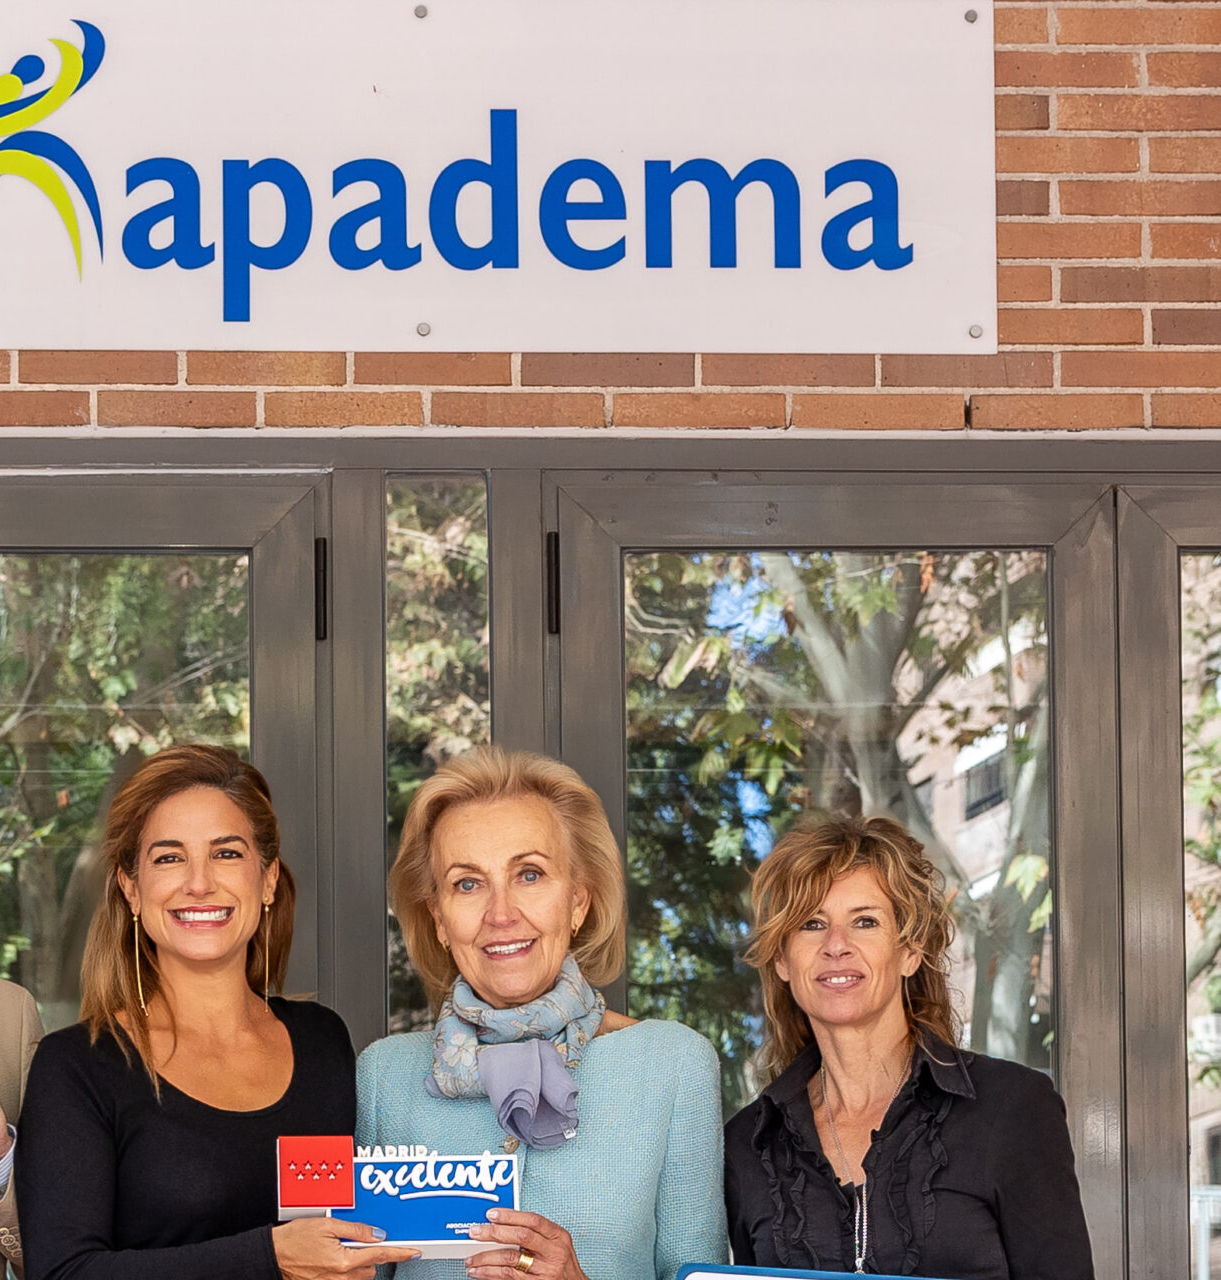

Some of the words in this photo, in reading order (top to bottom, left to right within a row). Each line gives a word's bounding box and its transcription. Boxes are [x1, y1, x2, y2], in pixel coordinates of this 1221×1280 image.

[121, 109, 914, 322] apadema
[357, 1145, 427, 1158] MADRID
[360, 1150, 514, 1196] excelente
